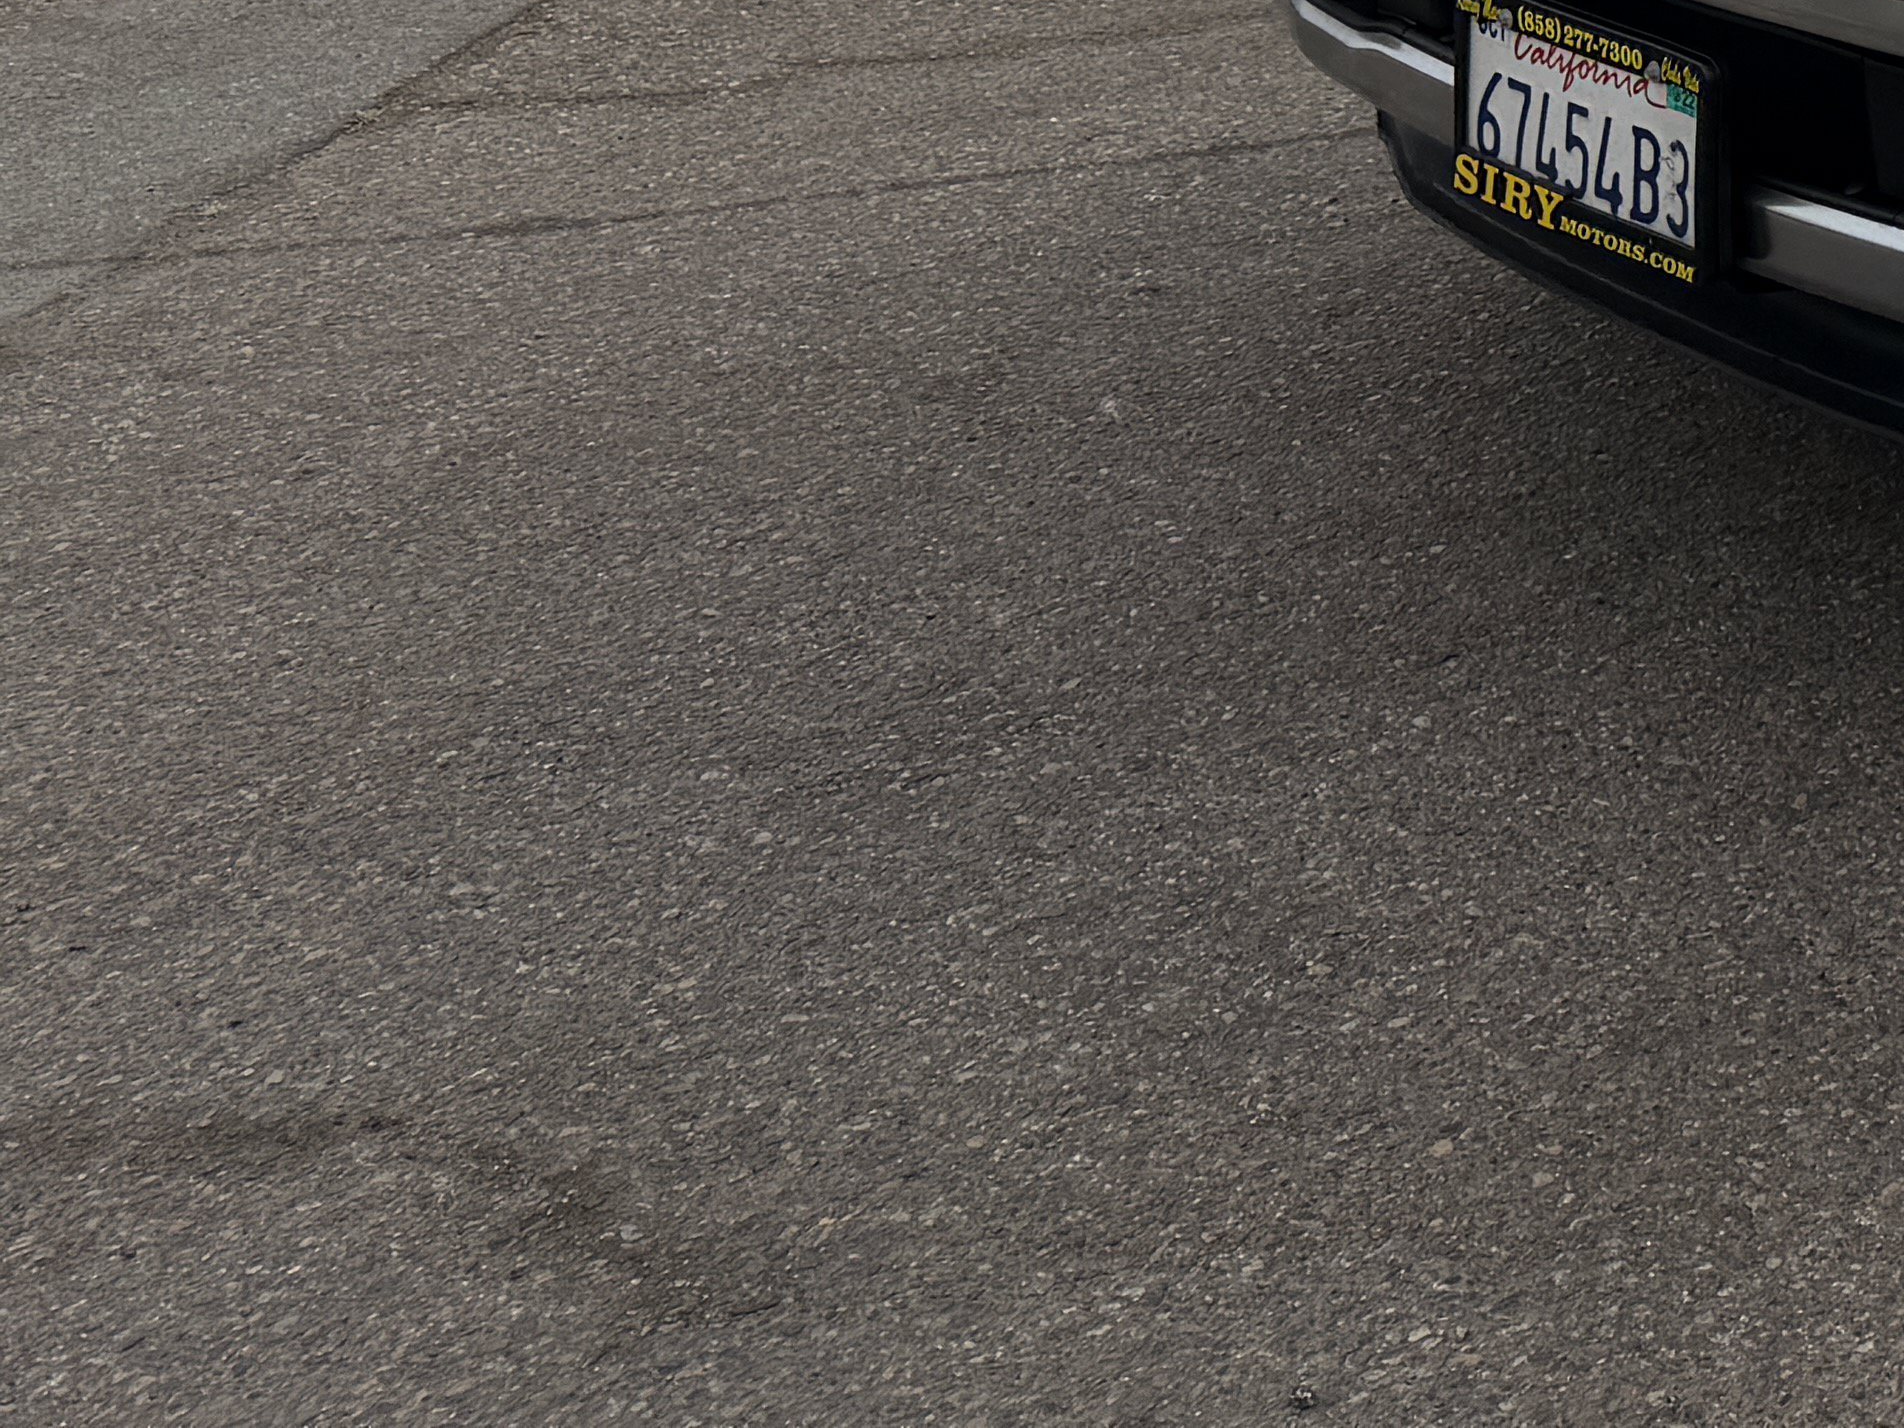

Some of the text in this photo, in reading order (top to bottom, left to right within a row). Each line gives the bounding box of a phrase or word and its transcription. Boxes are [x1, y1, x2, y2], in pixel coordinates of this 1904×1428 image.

[1513, 32, 1668, 110] California
[1517, 5, 1643, 71] (858) 277-7300
[1453, 153, 1696, 283] SIRY MOTORS.COM
